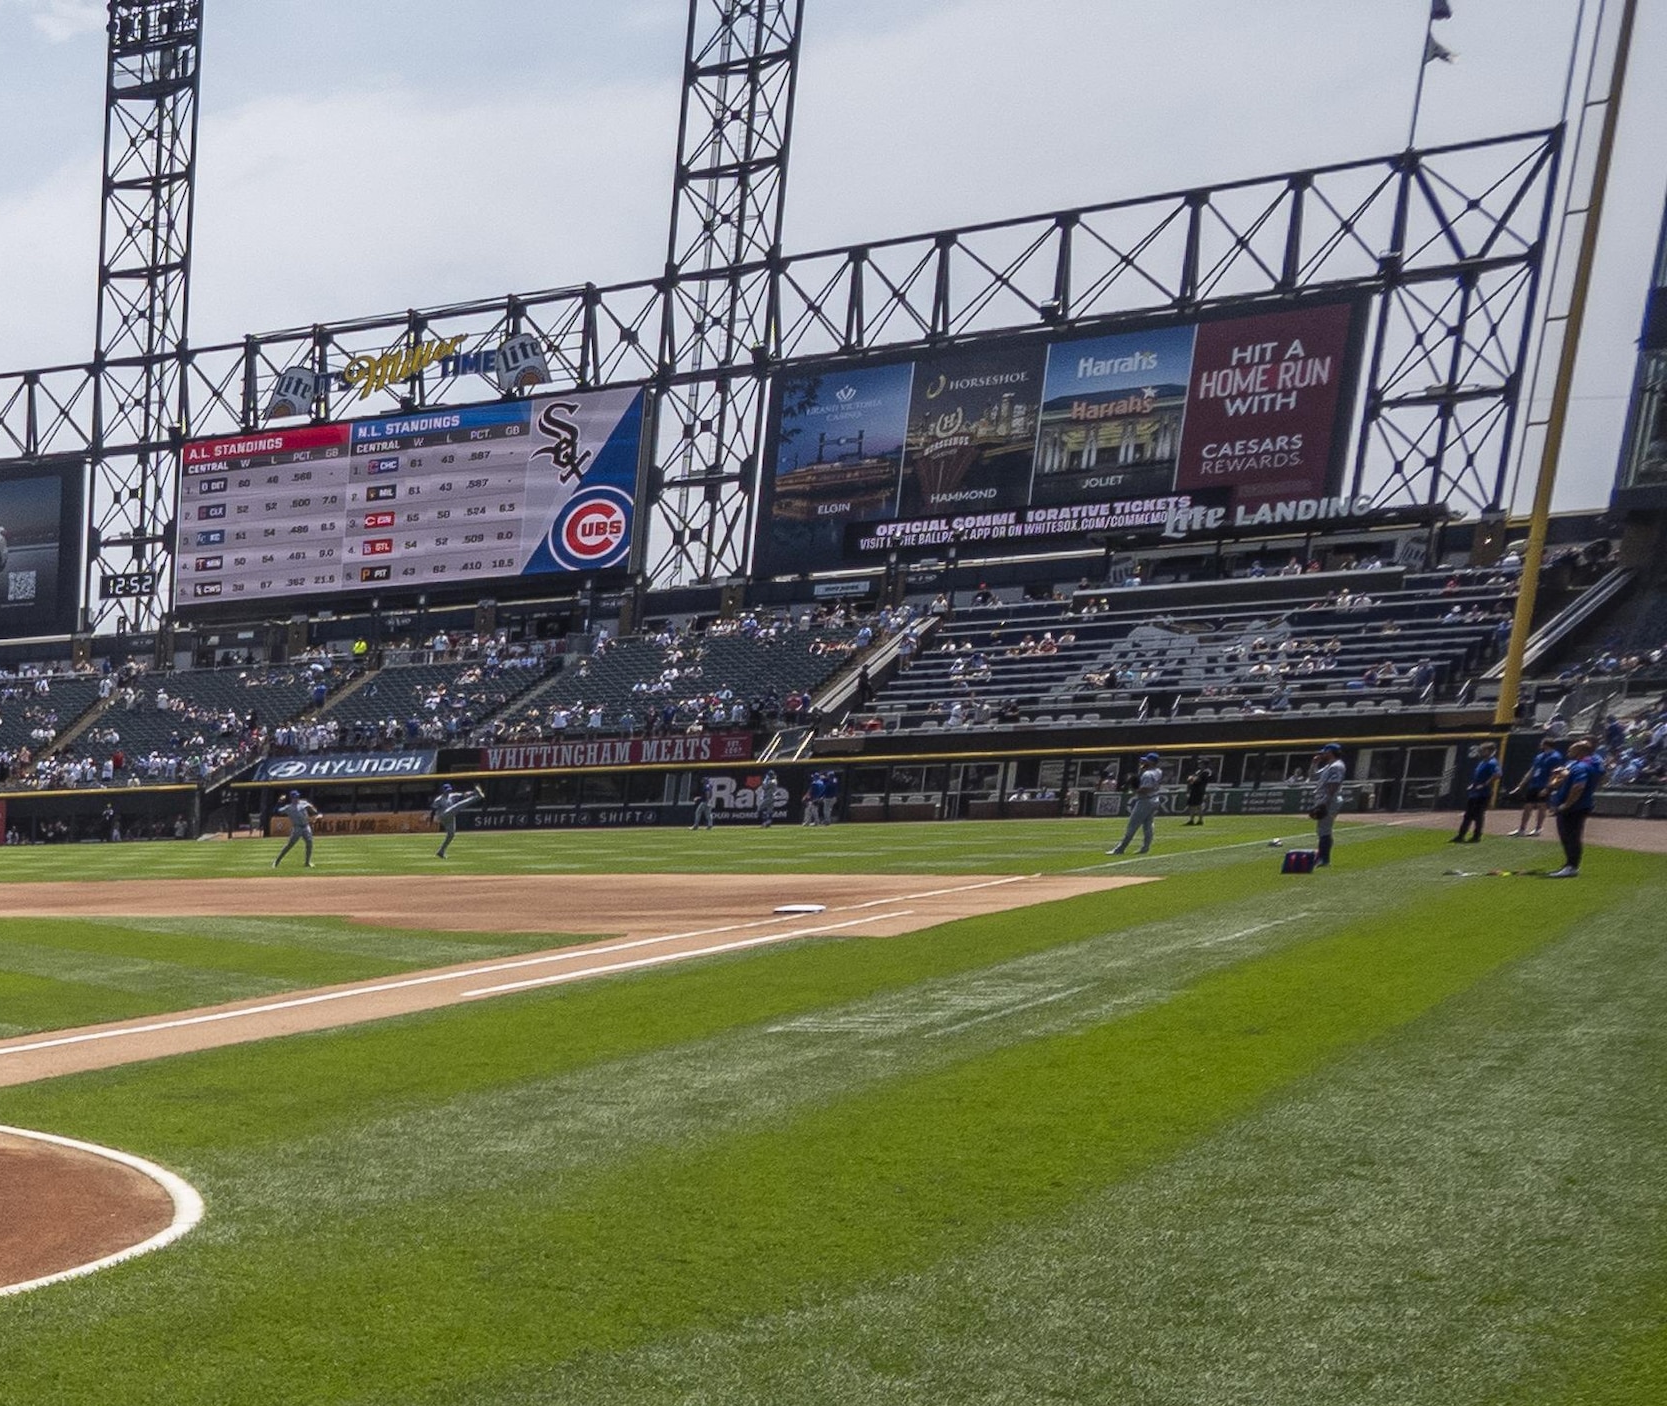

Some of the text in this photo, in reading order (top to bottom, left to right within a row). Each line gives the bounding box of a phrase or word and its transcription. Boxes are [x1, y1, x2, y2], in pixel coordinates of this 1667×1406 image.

[500, 340, 540, 373] Lite
[1232, 339, 1305, 366] HIT A
[344, 334, 467, 400] Miller
[1199, 356, 1331, 400] HOME RUN
[276, 376, 312, 398] Lite
[949, 371, 1029, 391] HORSESHOE
[1225, 391, 1297, 417] WITH
[358, 415, 460, 438] N.L. STANDINGS
[189, 438, 283, 460] A.L. STANDINGS
[357, 426, 519, 453] CENTRAL W L PCT. GB
[1202, 434, 1303, 459] CAESARS
[188, 448, 338, 474] CENTRAL W PCT. GB
[439, 483, 452, 491] 43
[1083, 475, 1124, 489] JOLIET
[323, 496, 337, 504] 7.0
[931, 488, 997, 504] HAMMOND
[818, 503, 850, 515] ELGIN
[876, 496, 1191, 537] OFFICIAL TICKETS
[1235, 495, 1372, 527] LANDING
[860, 537, 885, 550] VISIT
[970, 526, 990, 539] APP
[992, 526, 1005, 538] OR
[1008, 525, 1022, 537] ON
[110, 575, 152, 594] 12:52
[311, 756, 421, 775] HYUNDAI
[487, 741, 631, 770] WHITTINGHAM
[641, 737, 711, 763] MEATS
